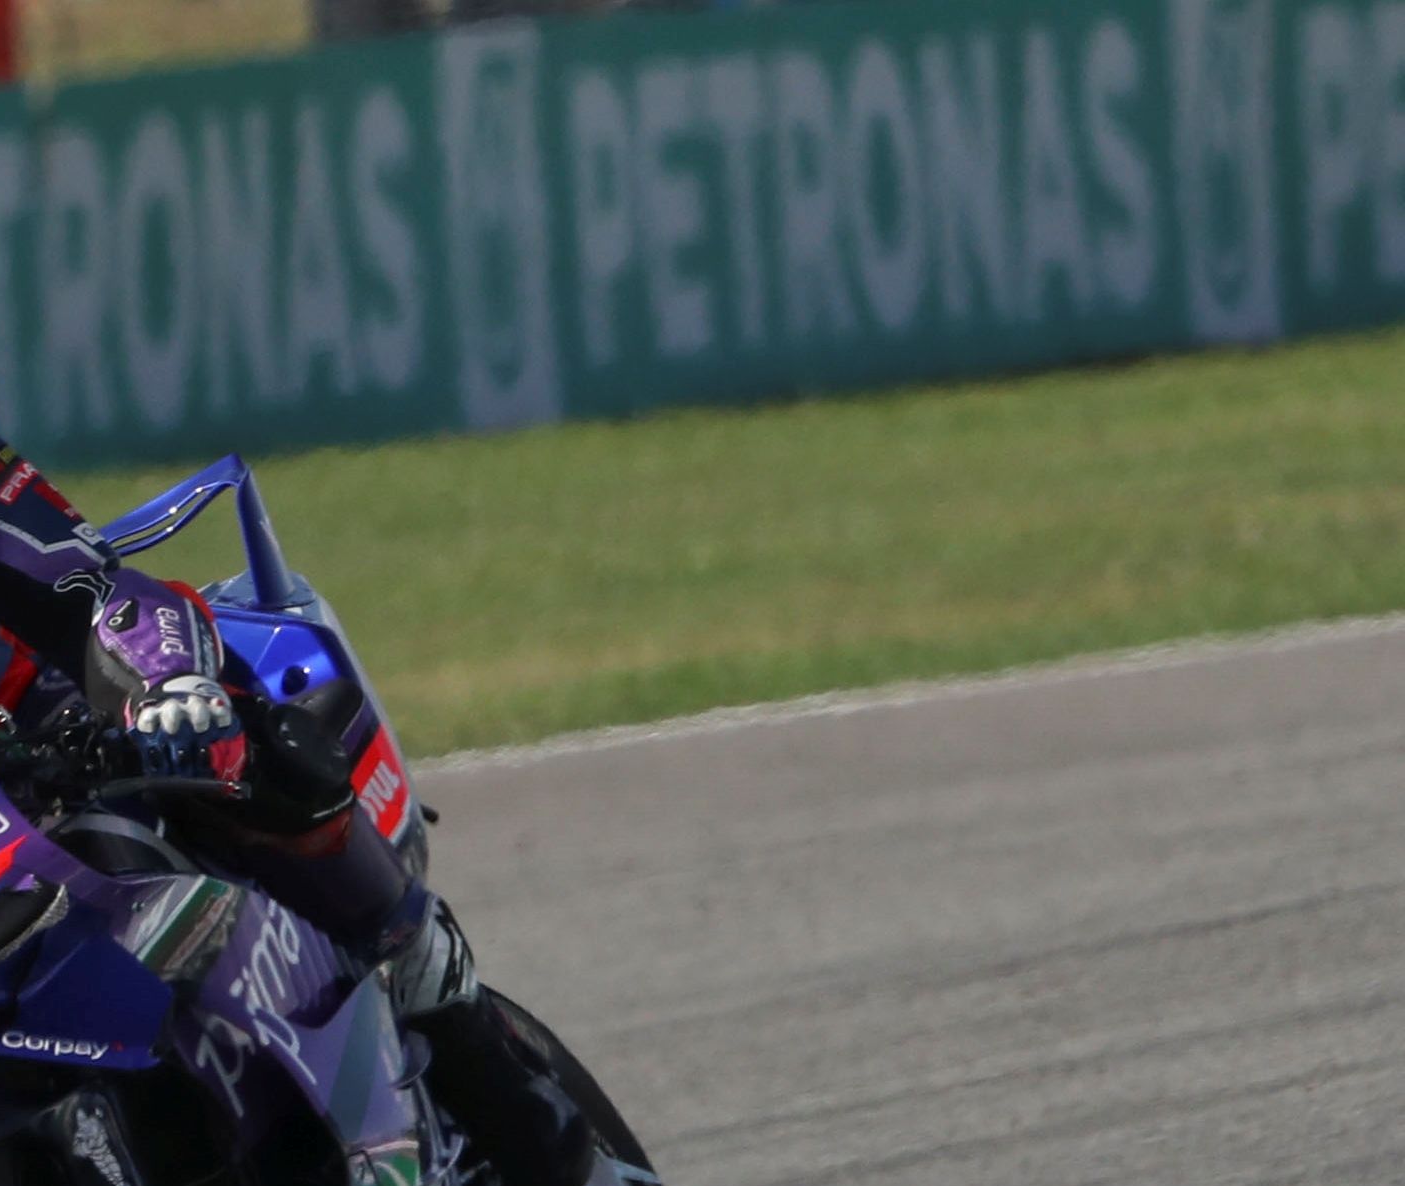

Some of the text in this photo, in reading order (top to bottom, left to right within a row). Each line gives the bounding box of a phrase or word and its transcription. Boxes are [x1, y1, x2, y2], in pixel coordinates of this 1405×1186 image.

[568, 20, 1160, 364] PETRONAS
[0, 460, 39, 502] PRA
[160, 606, 190, 656] prima
[362, 761, 402, 826] TUL
[0, 1030, 109, 1061] Corpay
